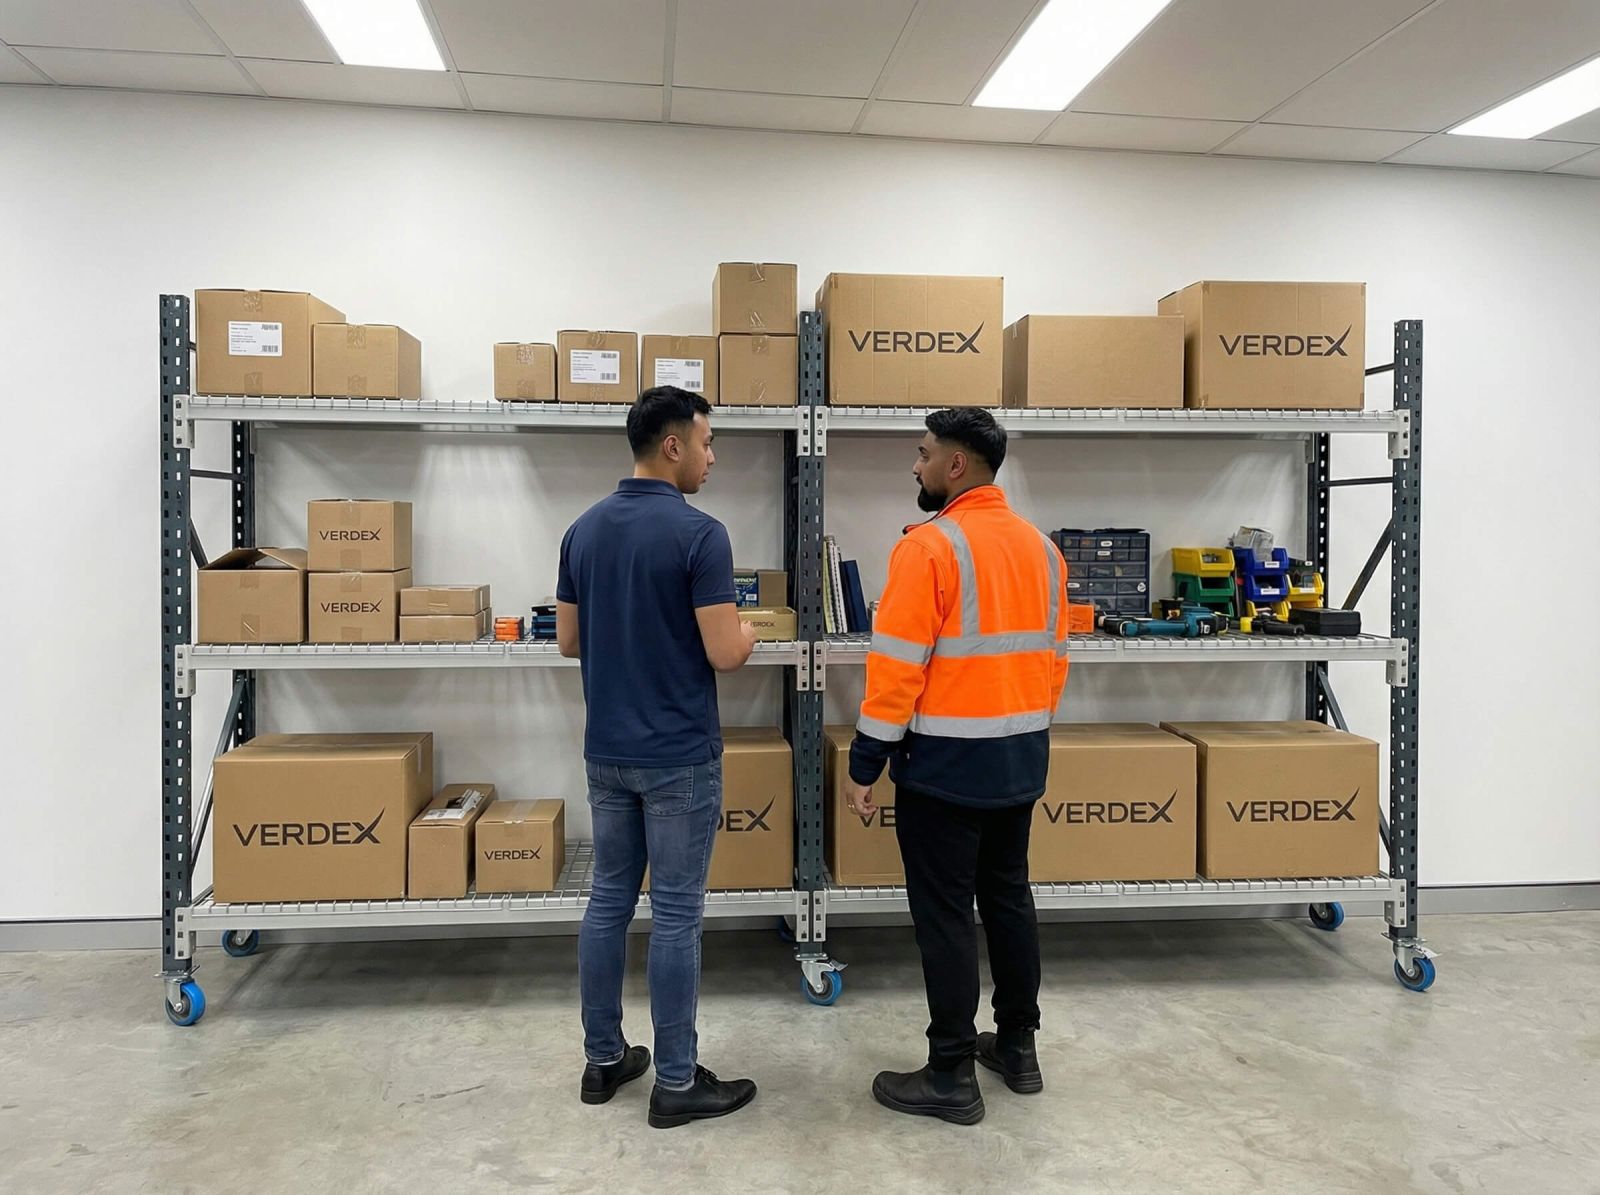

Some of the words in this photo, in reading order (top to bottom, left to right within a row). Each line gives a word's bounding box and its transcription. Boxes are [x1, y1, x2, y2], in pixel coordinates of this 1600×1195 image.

[848, 320, 985, 354] VERDEX
[1218, 323, 1352, 357] VERDEX
[319, 526, 382, 541] VERDEX
[320, 598, 383, 613] VERDEX
[1041, 788, 1178, 823] VERDEX
[1226, 786, 1360, 822] VERDEX
[232, 806, 386, 847] VERDEX
[484, 844, 543, 860] VERDEX
